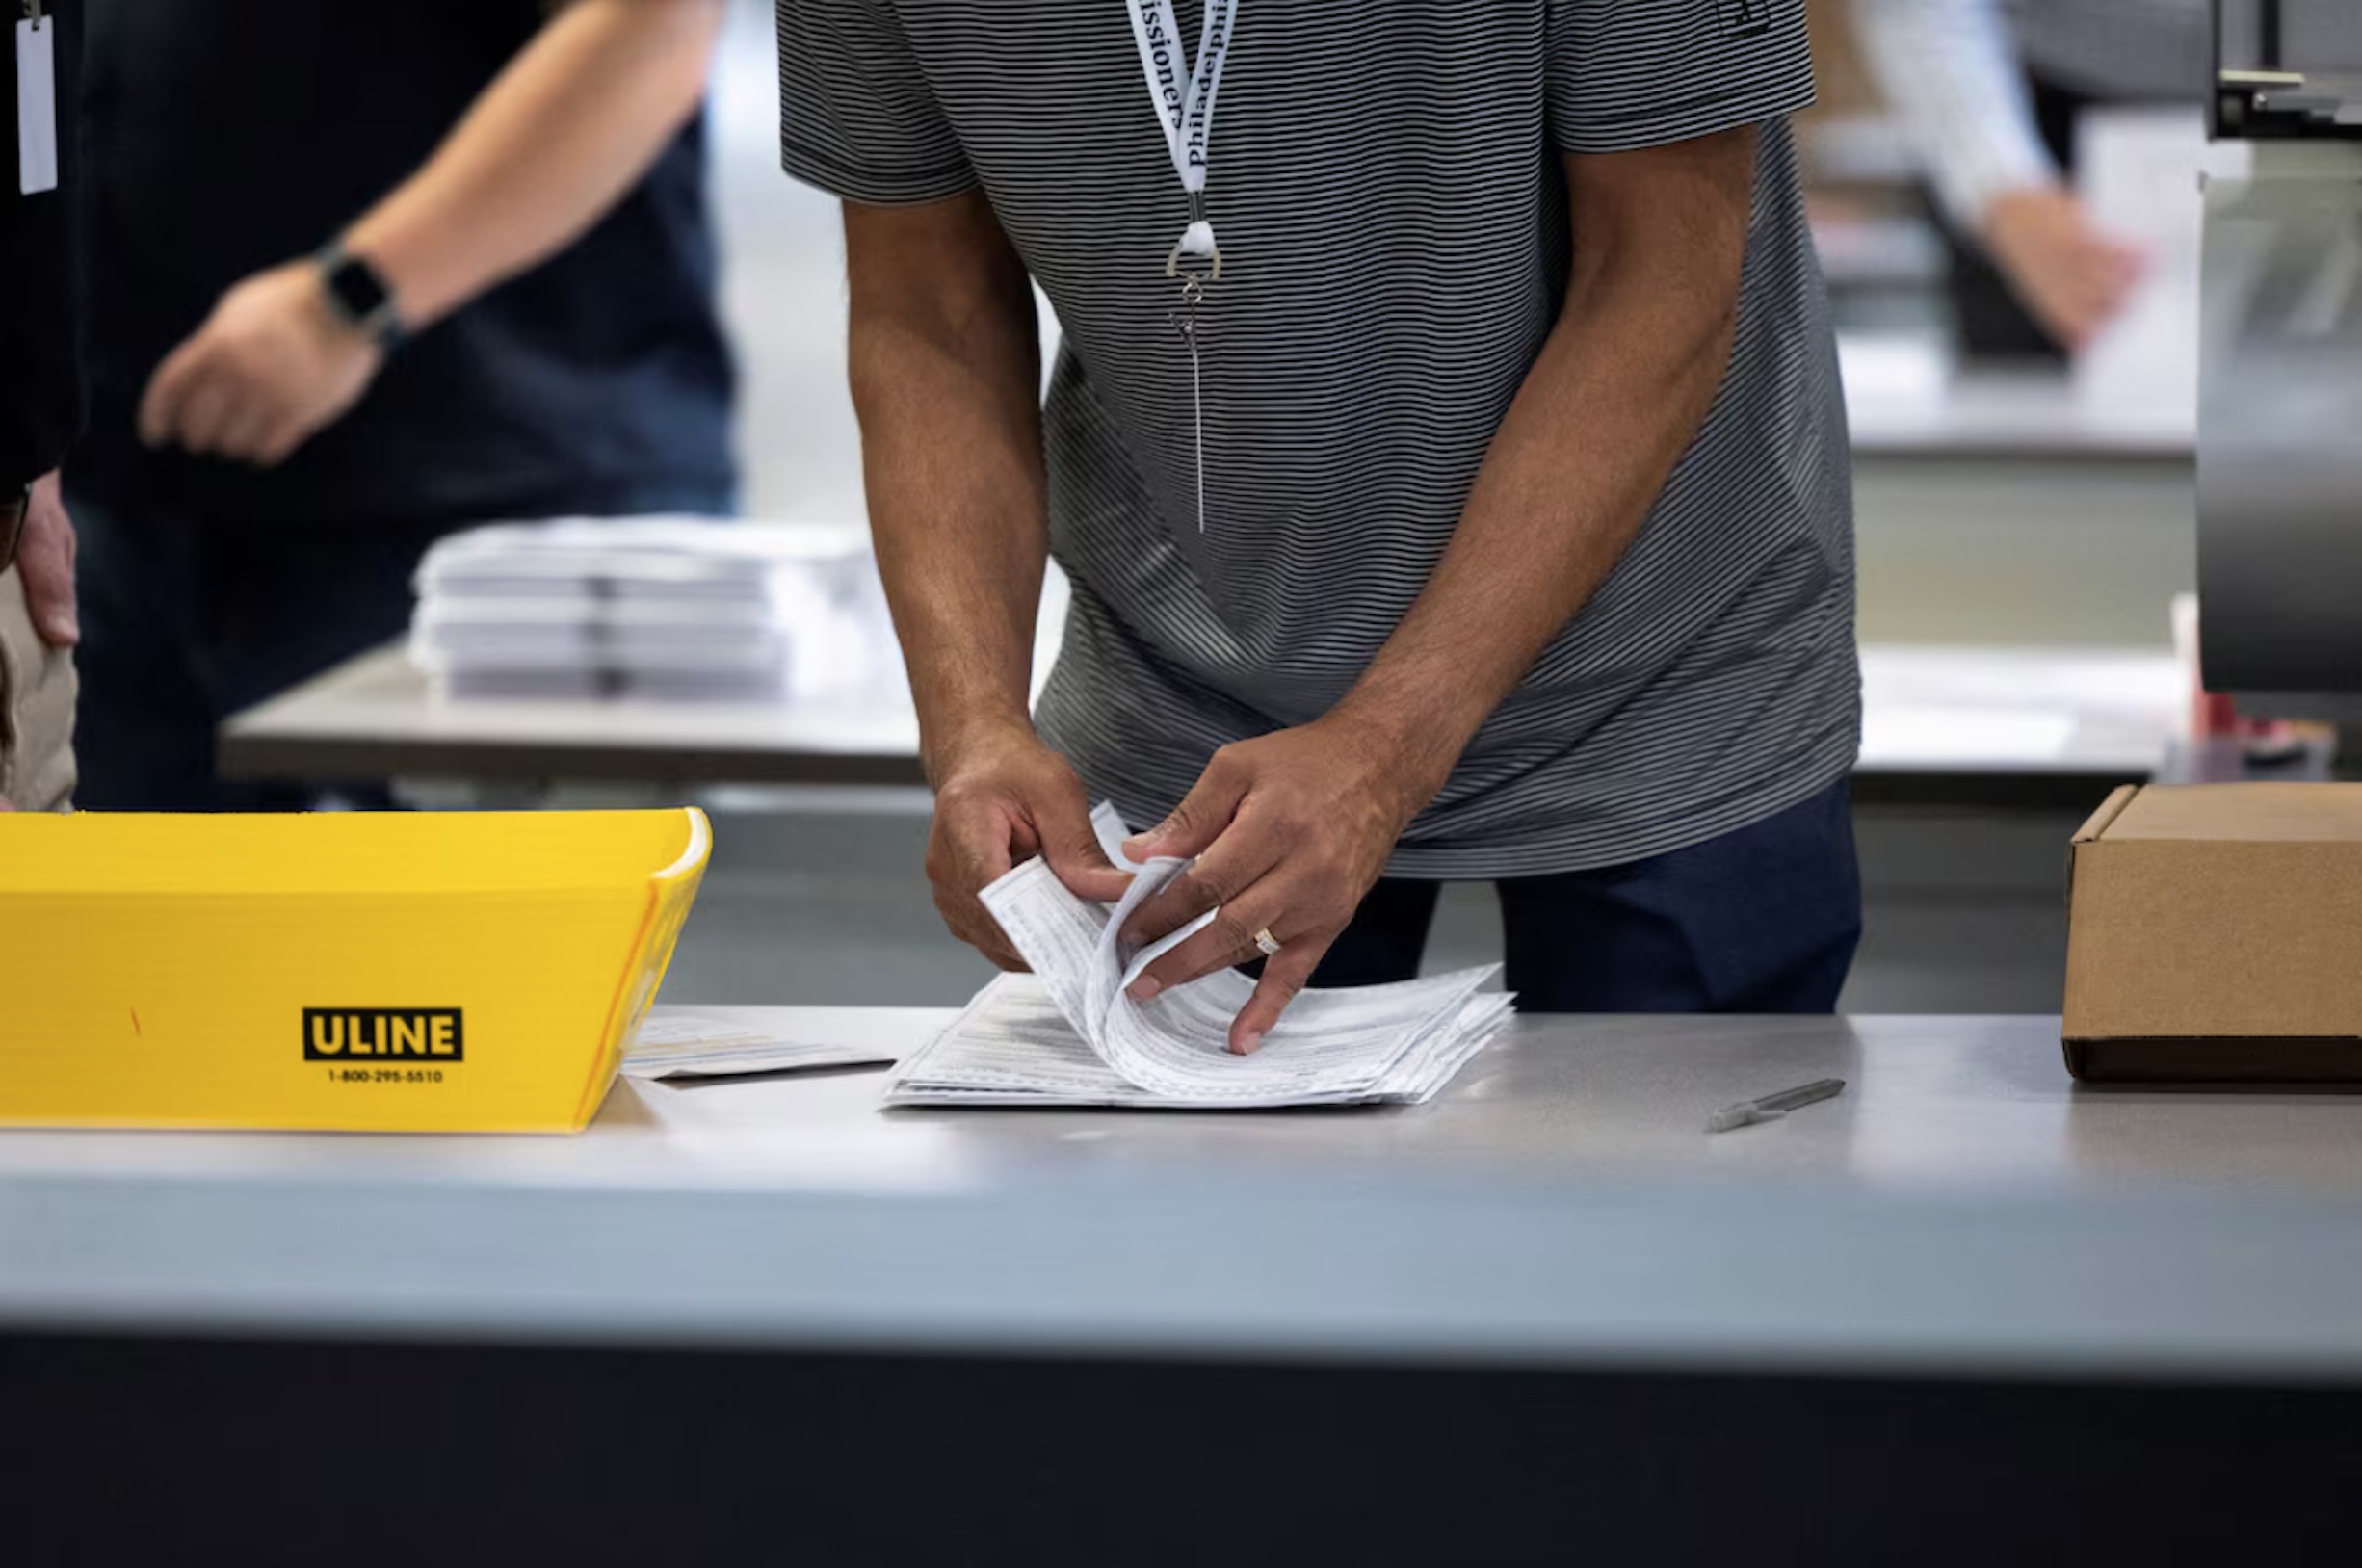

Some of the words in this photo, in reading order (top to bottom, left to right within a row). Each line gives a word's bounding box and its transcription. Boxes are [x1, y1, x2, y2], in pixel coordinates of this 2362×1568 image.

[1139, 0, 1183, 130] issioners
[311, 1014, 456, 1055] ULINE
[328, 1069, 444, 1084] 1-800-295-5510
